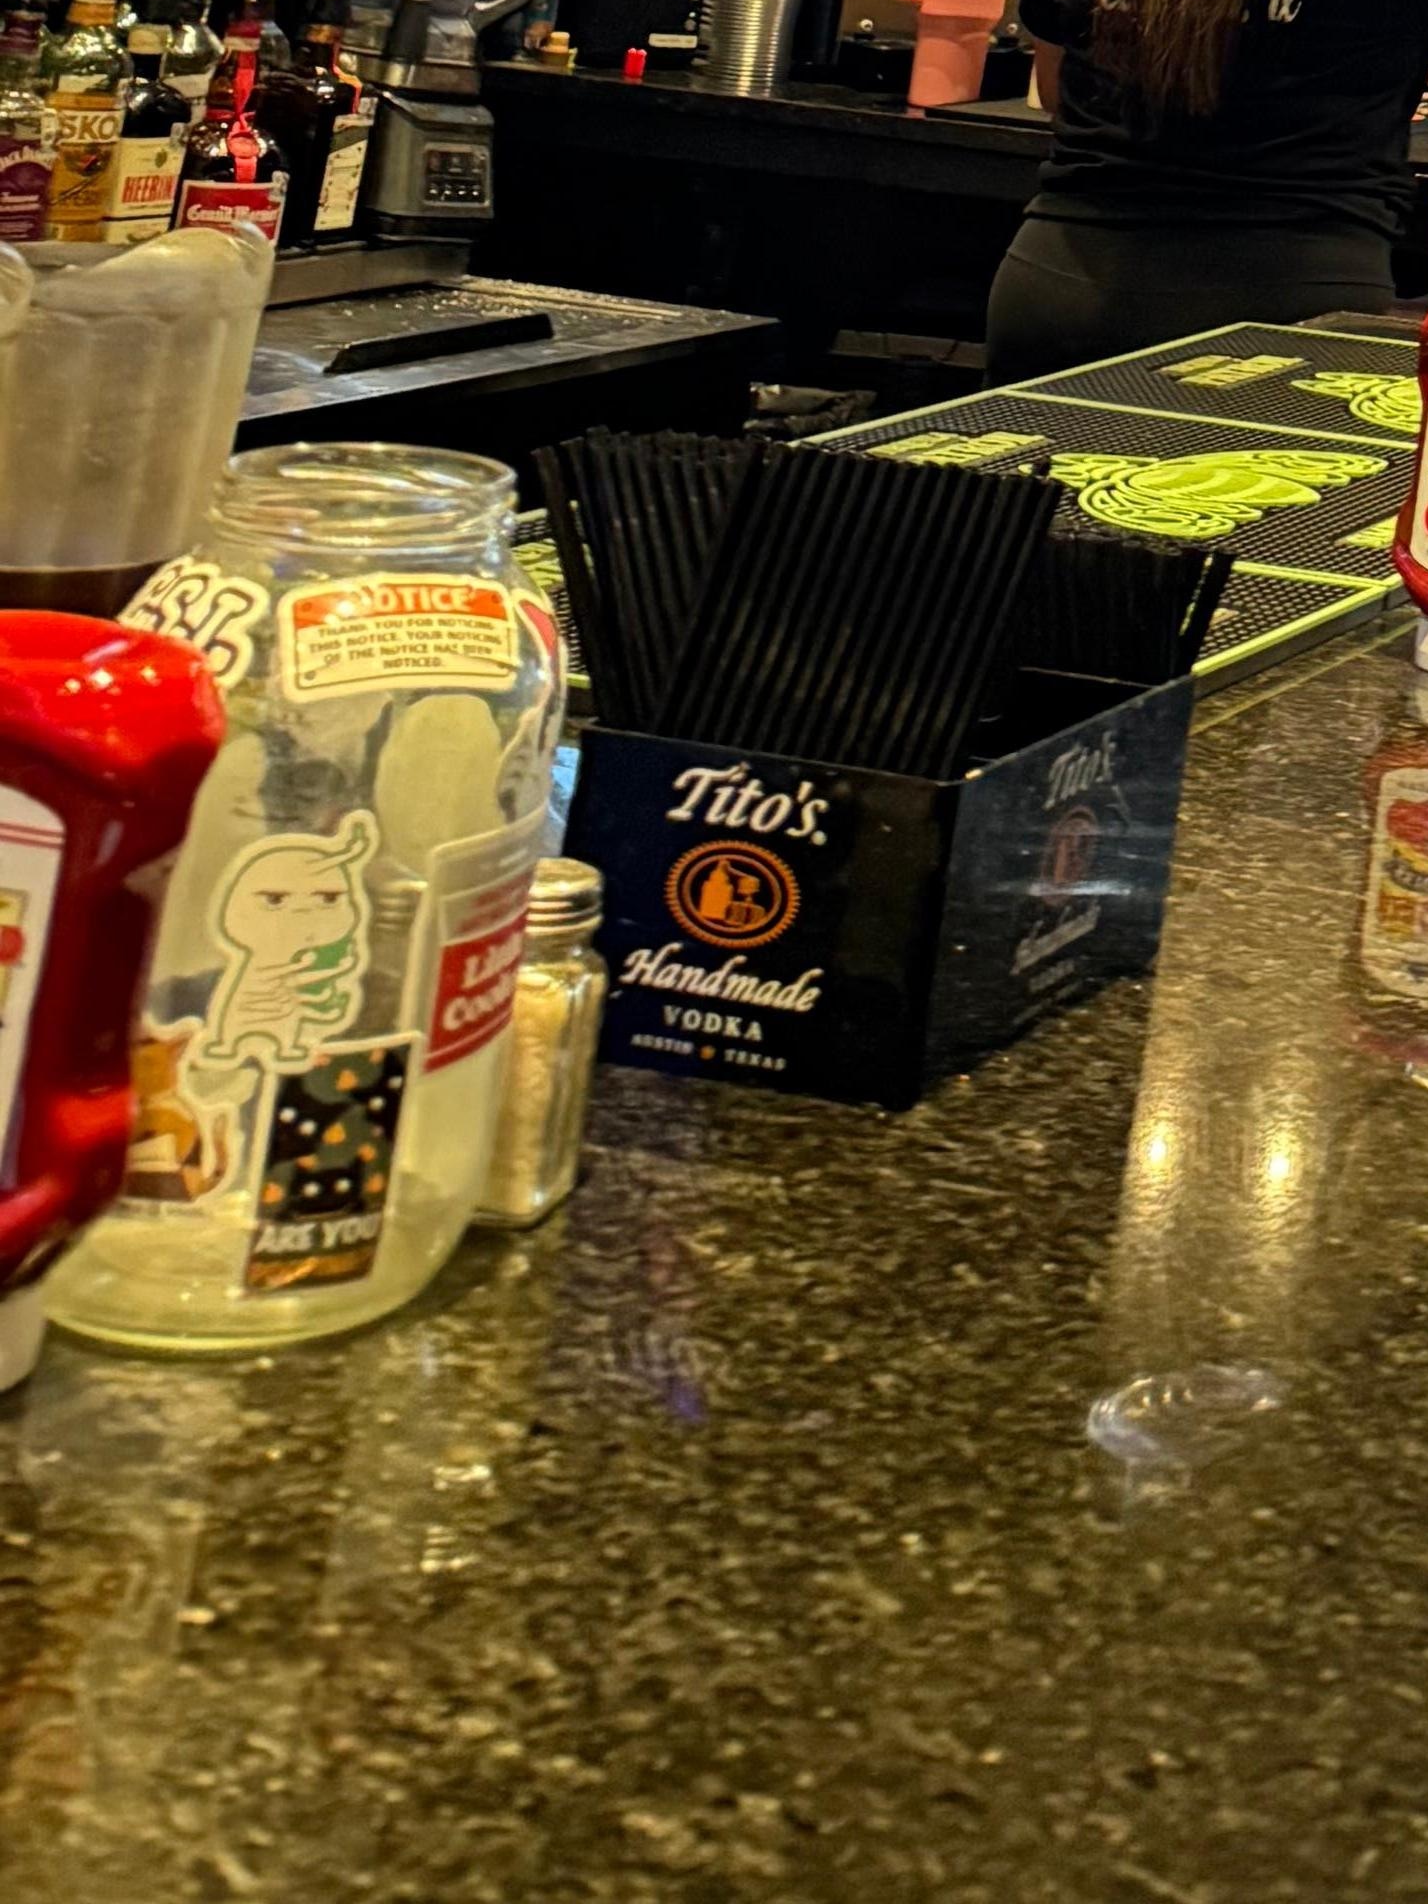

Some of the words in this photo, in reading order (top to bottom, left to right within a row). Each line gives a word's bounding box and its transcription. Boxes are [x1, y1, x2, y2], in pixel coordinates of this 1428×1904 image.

[375, 619, 404, 630] YOU
[407, 618, 434, 628] FOR
[309, 641, 342, 653] THIS
[348, 648, 375, 661] THE
[380, 643, 429, 656] NOTICE
[619, 941, 825, 1014] Handmade
[663, 1003, 763, 1042] VODKA
[630, 1033, 695, 1055] AUSTIN
[723, 1046, 787, 1072] TEXAS
